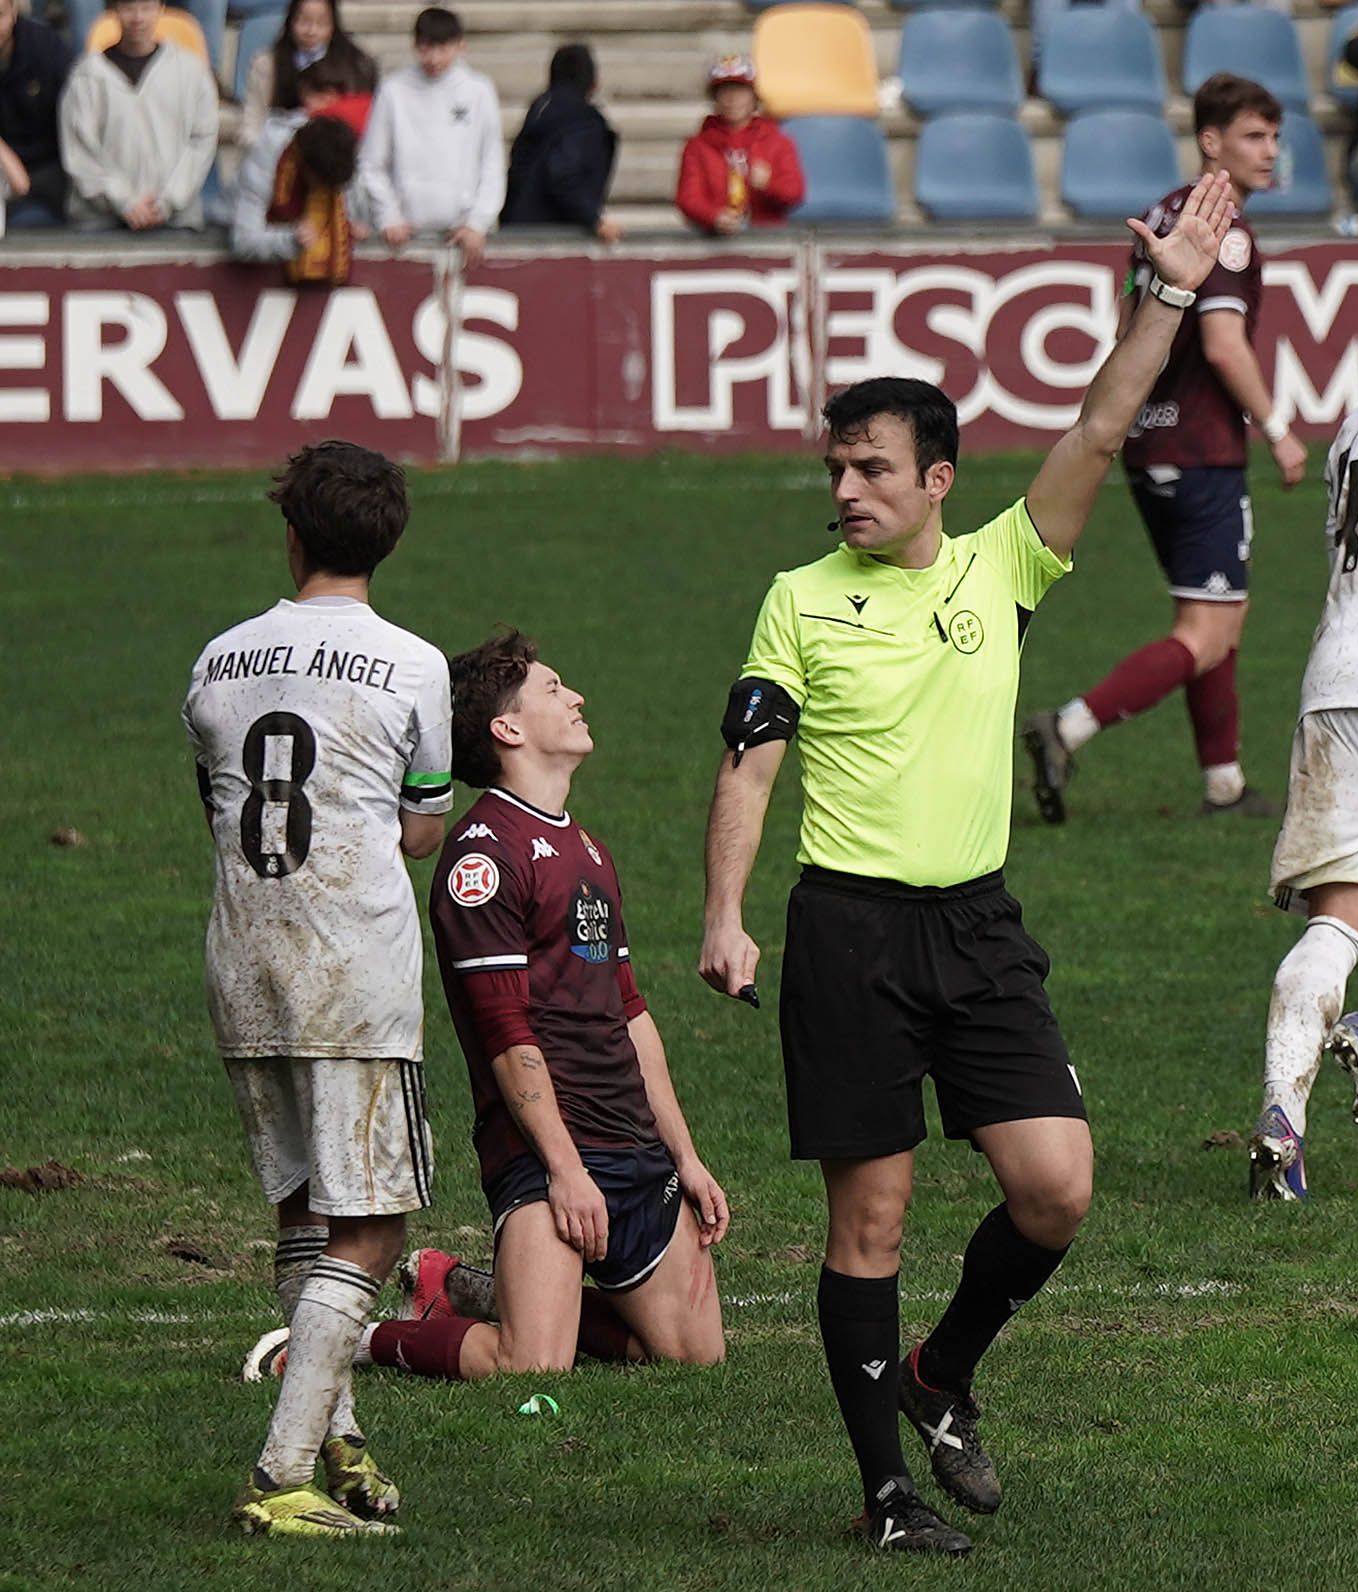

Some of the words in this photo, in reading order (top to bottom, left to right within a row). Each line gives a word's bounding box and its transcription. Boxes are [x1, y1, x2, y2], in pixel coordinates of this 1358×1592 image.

[957, 618, 974, 632] RF
[960, 631, 977, 645] EF
[203, 646, 298, 687] MANUEL
[306, 641, 397, 695] ÁNGEL
[240, 711, 314, 878] 8
